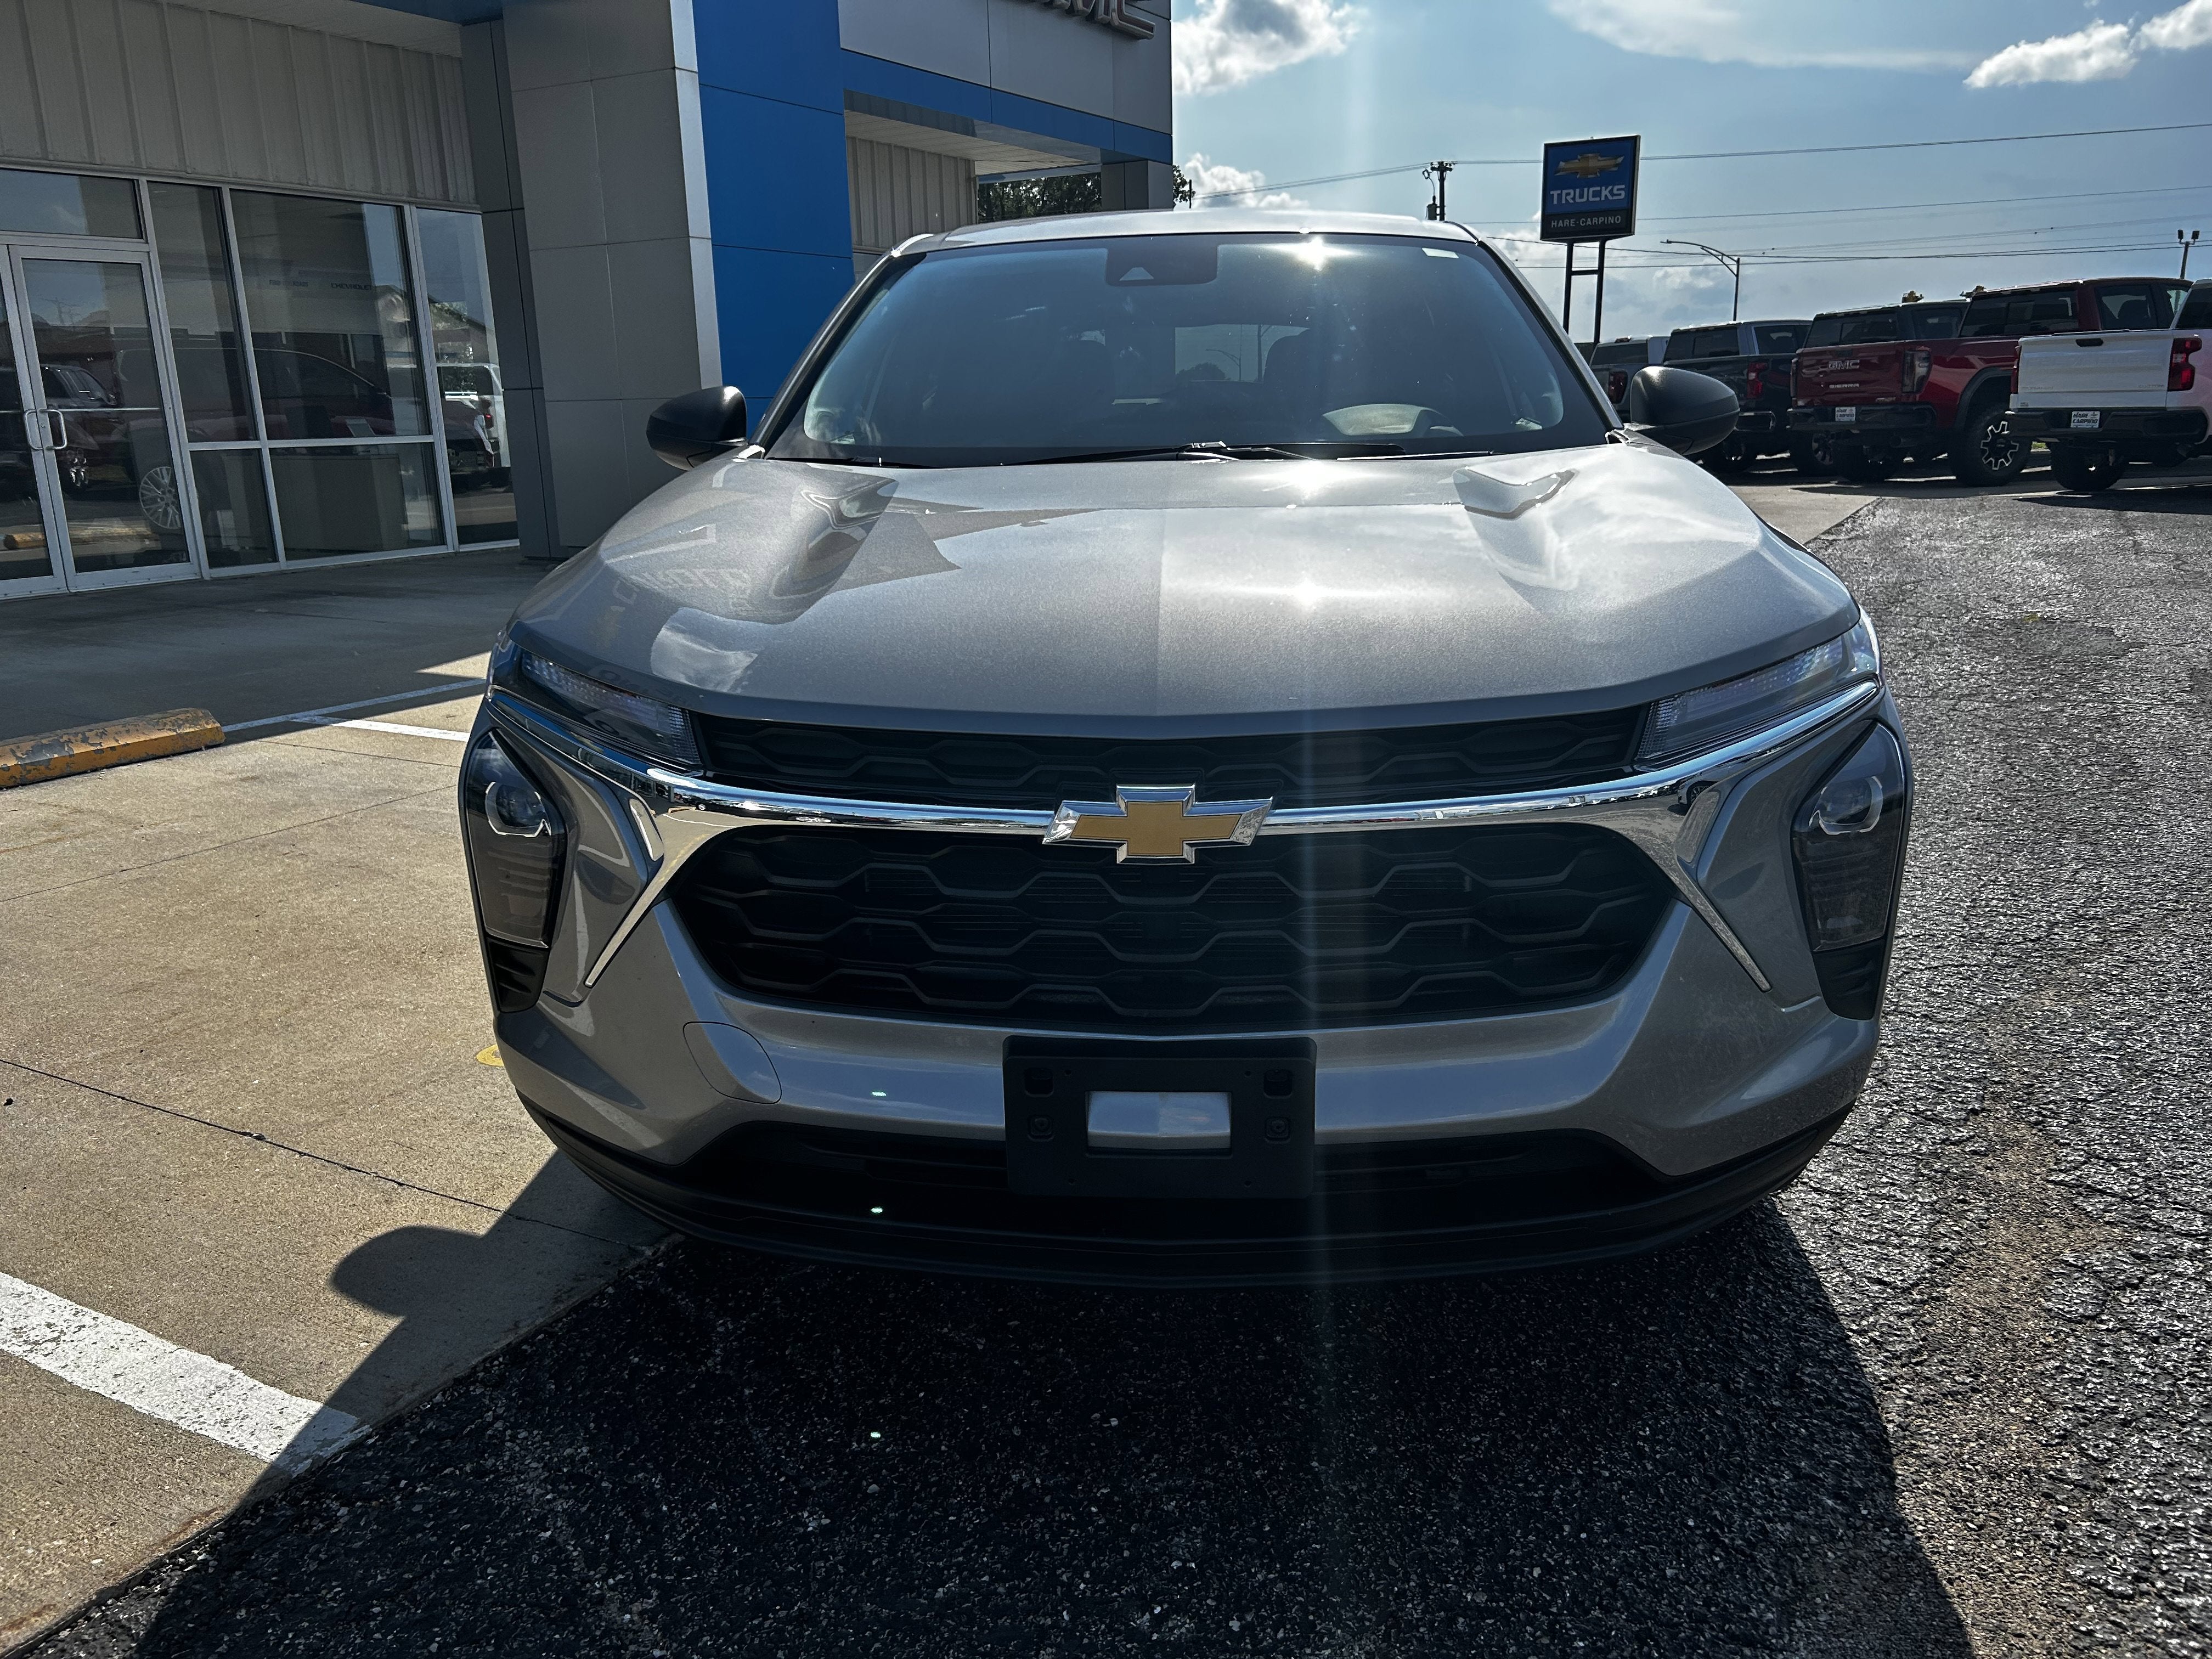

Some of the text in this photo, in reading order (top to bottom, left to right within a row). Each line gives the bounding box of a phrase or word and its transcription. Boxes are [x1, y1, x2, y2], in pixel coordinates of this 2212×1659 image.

[1550, 185, 1625, 205] TRUCKS
[1551, 216, 1621, 228] HARE-CARPINO
[1829, 359, 1859, 369] GMC
